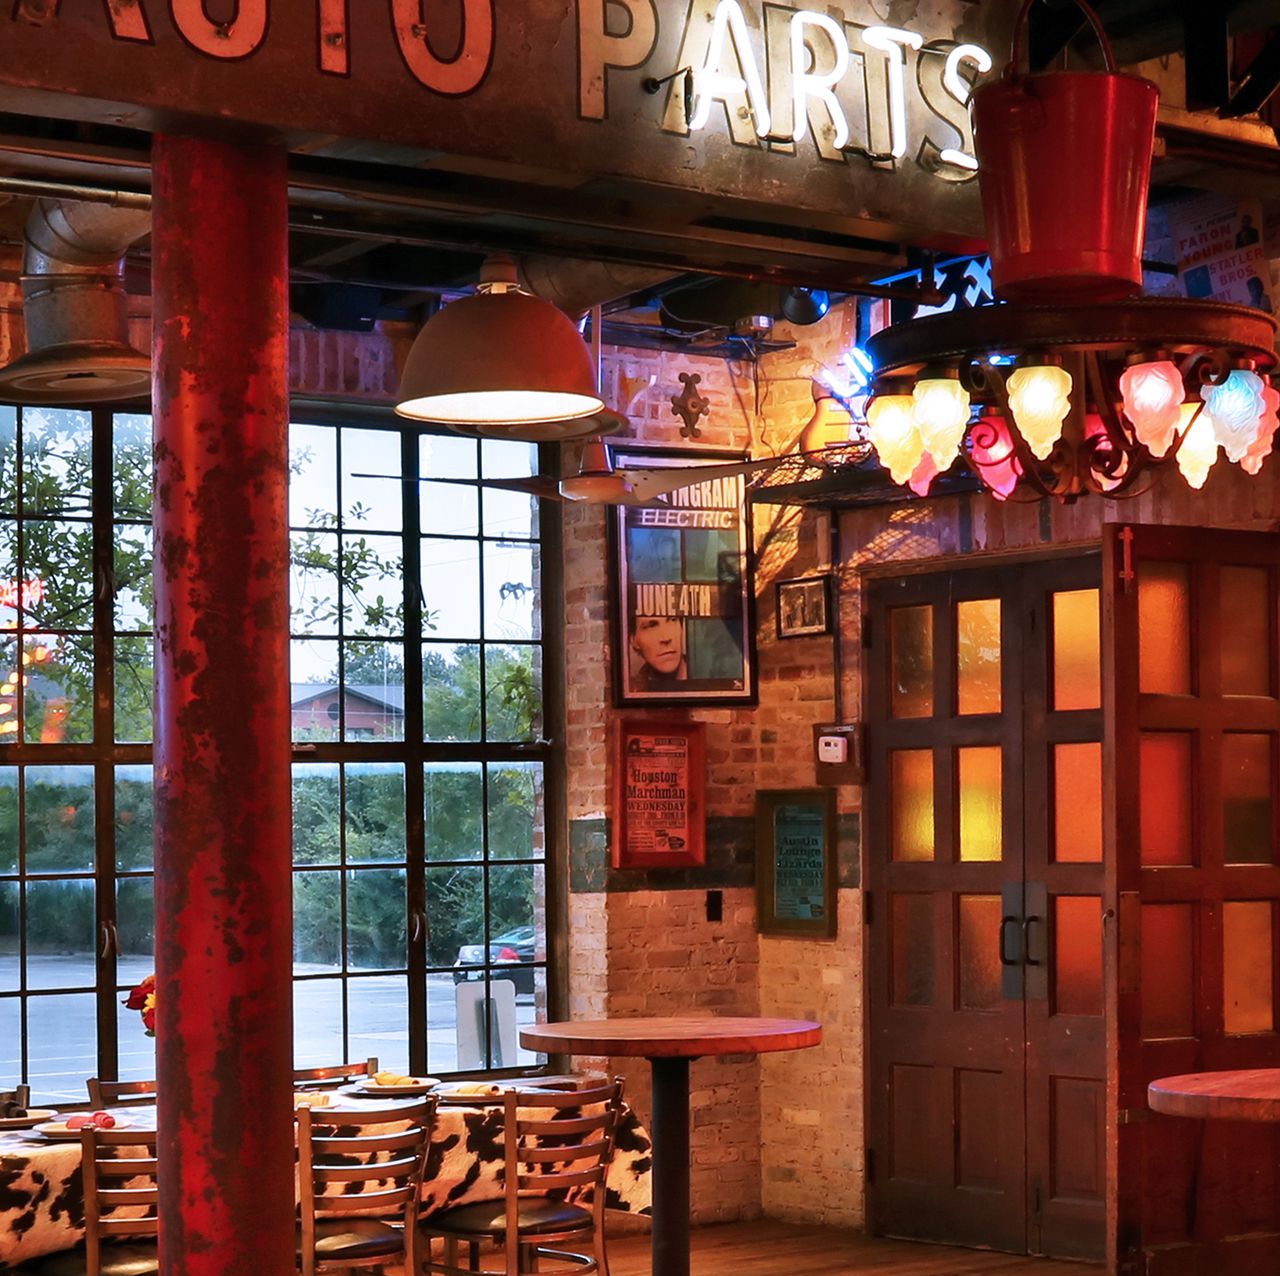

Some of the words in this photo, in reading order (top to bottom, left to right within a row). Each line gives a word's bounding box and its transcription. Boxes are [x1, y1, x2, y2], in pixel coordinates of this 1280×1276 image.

[576, 0, 993, 184] PARTS
[1179, 224, 1232, 251] FARON
[1210, 248, 1264, 275] STATLER
[672, 476, 739, 508] INGRAM
[641, 508, 733, 528] ELECTRIC
[635, 584, 676, 617] JUNE
[678, 584, 711, 617] 4TH
[632, 767, 678, 783] Houston
[627, 785, 686, 799] Marchman
[628, 801, 686, 812] WEDNESDAY
